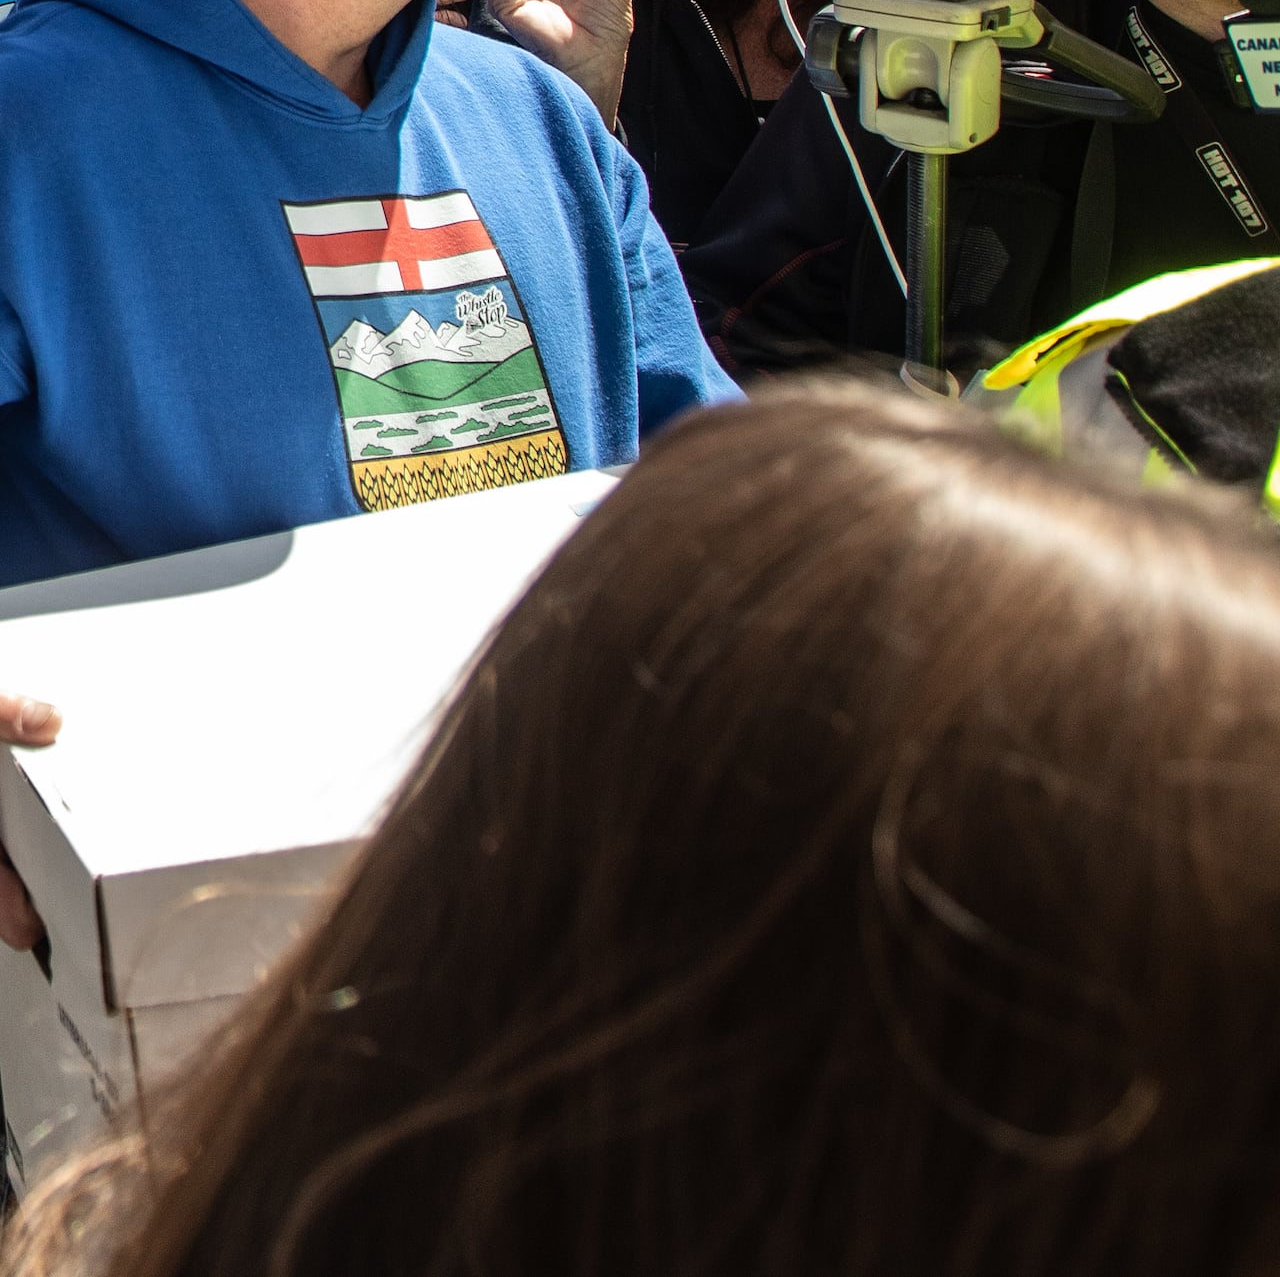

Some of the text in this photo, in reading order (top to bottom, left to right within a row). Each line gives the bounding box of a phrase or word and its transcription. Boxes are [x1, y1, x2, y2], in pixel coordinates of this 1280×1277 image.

[1236, 38, 1280, 52] CANA
[1202, 148, 1263, 227] HOT 107
[478, 304, 505, 329] Stop
